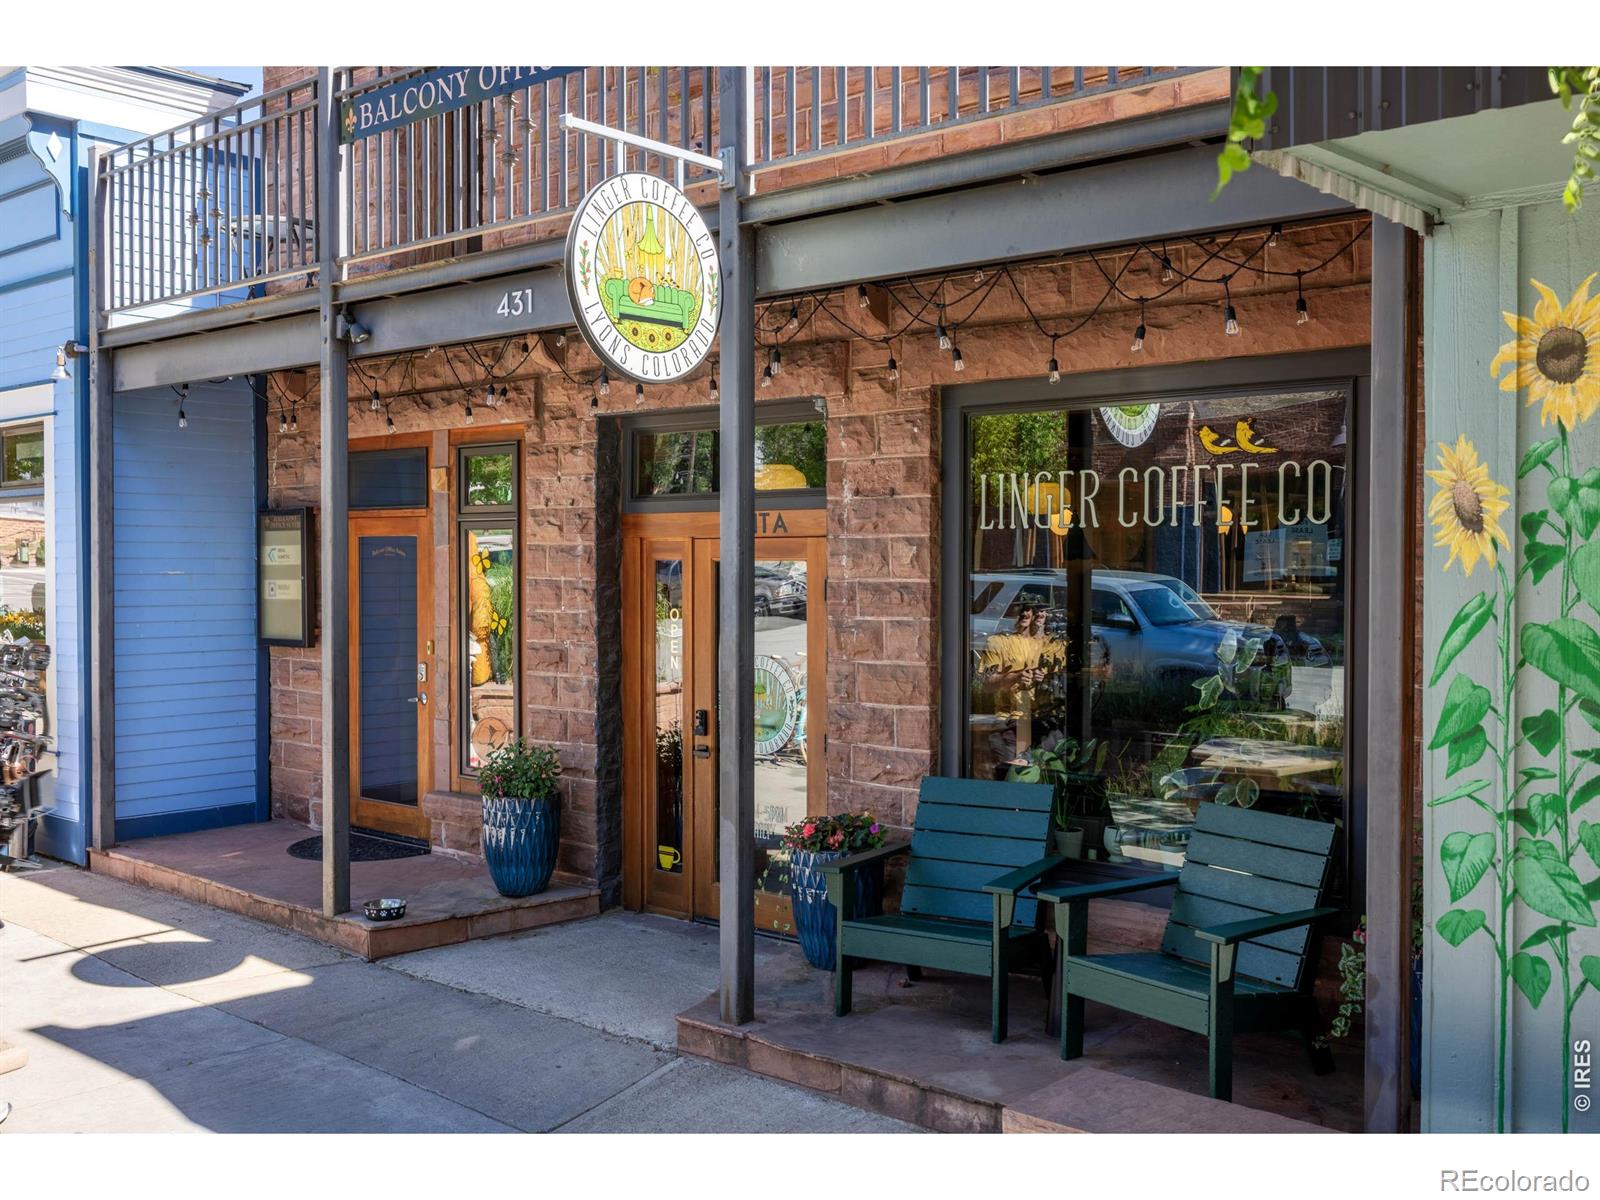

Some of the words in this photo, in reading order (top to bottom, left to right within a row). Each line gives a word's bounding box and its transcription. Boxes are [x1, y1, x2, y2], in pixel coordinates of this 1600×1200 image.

[359, 69, 470, 129] BALCONY
[582, 177, 631, 237] LINGER
[640, 176, 698, 230] COFFEE
[696, 233, 715, 260] CO
[497, 289, 532, 317] 431
[641, 318, 715, 377] COLORADO
[980, 469, 1100, 530] LINGER
[1118, 462, 1259, 528] COFFEE
[1277, 460, 1333, 525] CO
[669, 608, 679, 669] OPEN
